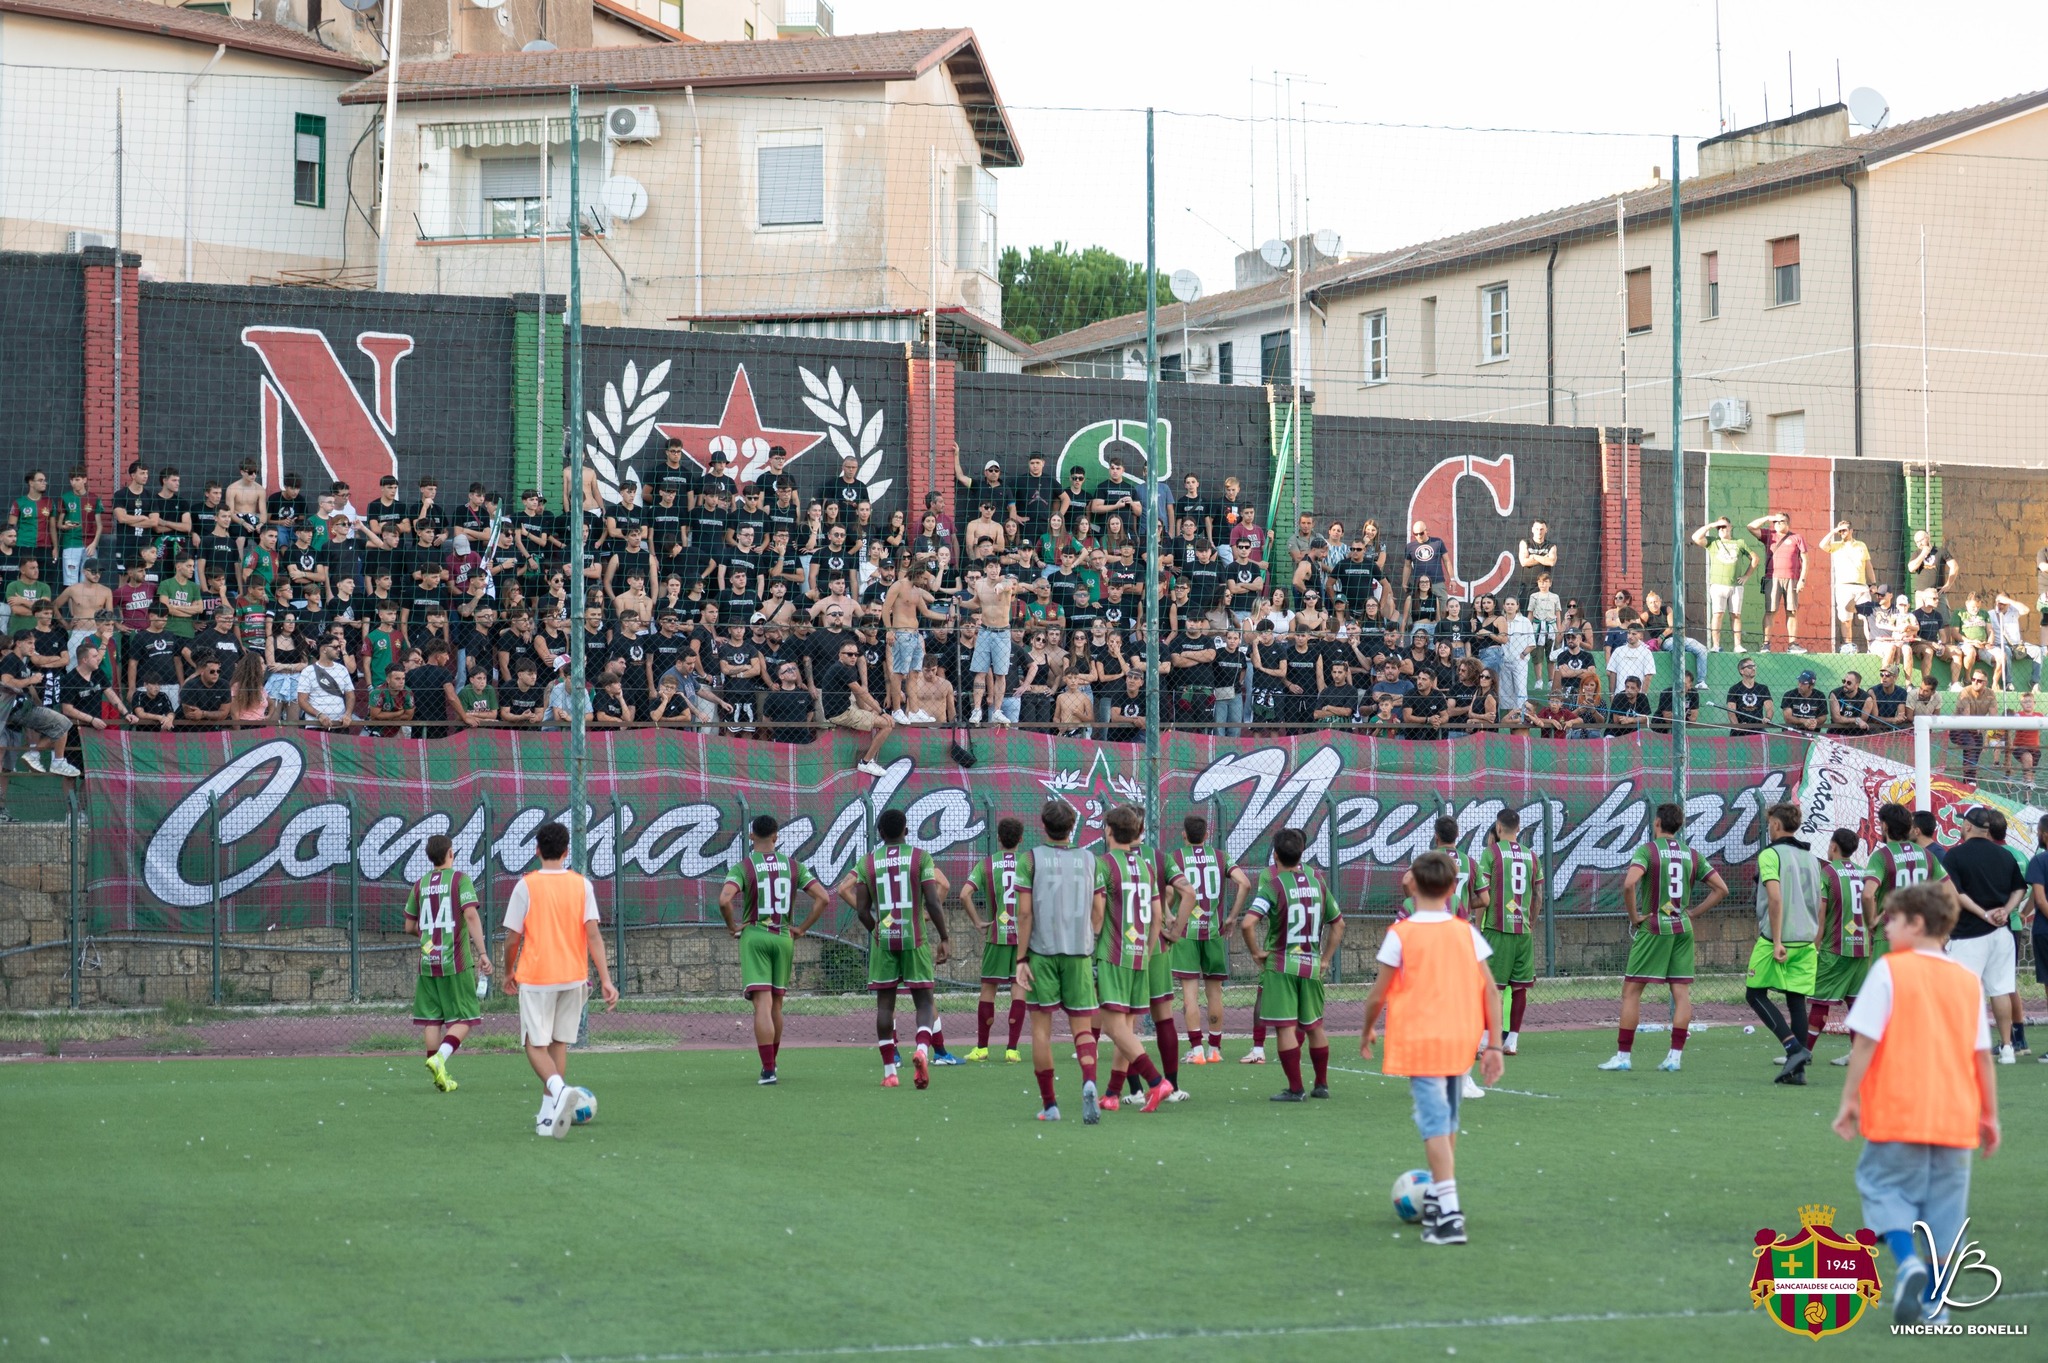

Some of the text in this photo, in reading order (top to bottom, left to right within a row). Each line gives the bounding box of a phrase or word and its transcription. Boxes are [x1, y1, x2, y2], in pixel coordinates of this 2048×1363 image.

[241, 325, 415, 515] N
[709, 435, 771, 486] 22
[1408, 454, 1516, 603] C
[1186, 550, 1195, 558] 22
[143, 737, 986, 908] Commando
[757, 877, 792, 914] 19
[876, 871, 913, 910] 11
[1184, 866, 1221, 900] 20
[1511, 862, 1527, 895] 8
[1667, 862, 1684, 898] 3
[1850, 879, 1865, 915] 6
[419, 896, 456, 935] 44
[1121, 881, 1153, 924] 73
[1287, 902, 1321, 944] 21
